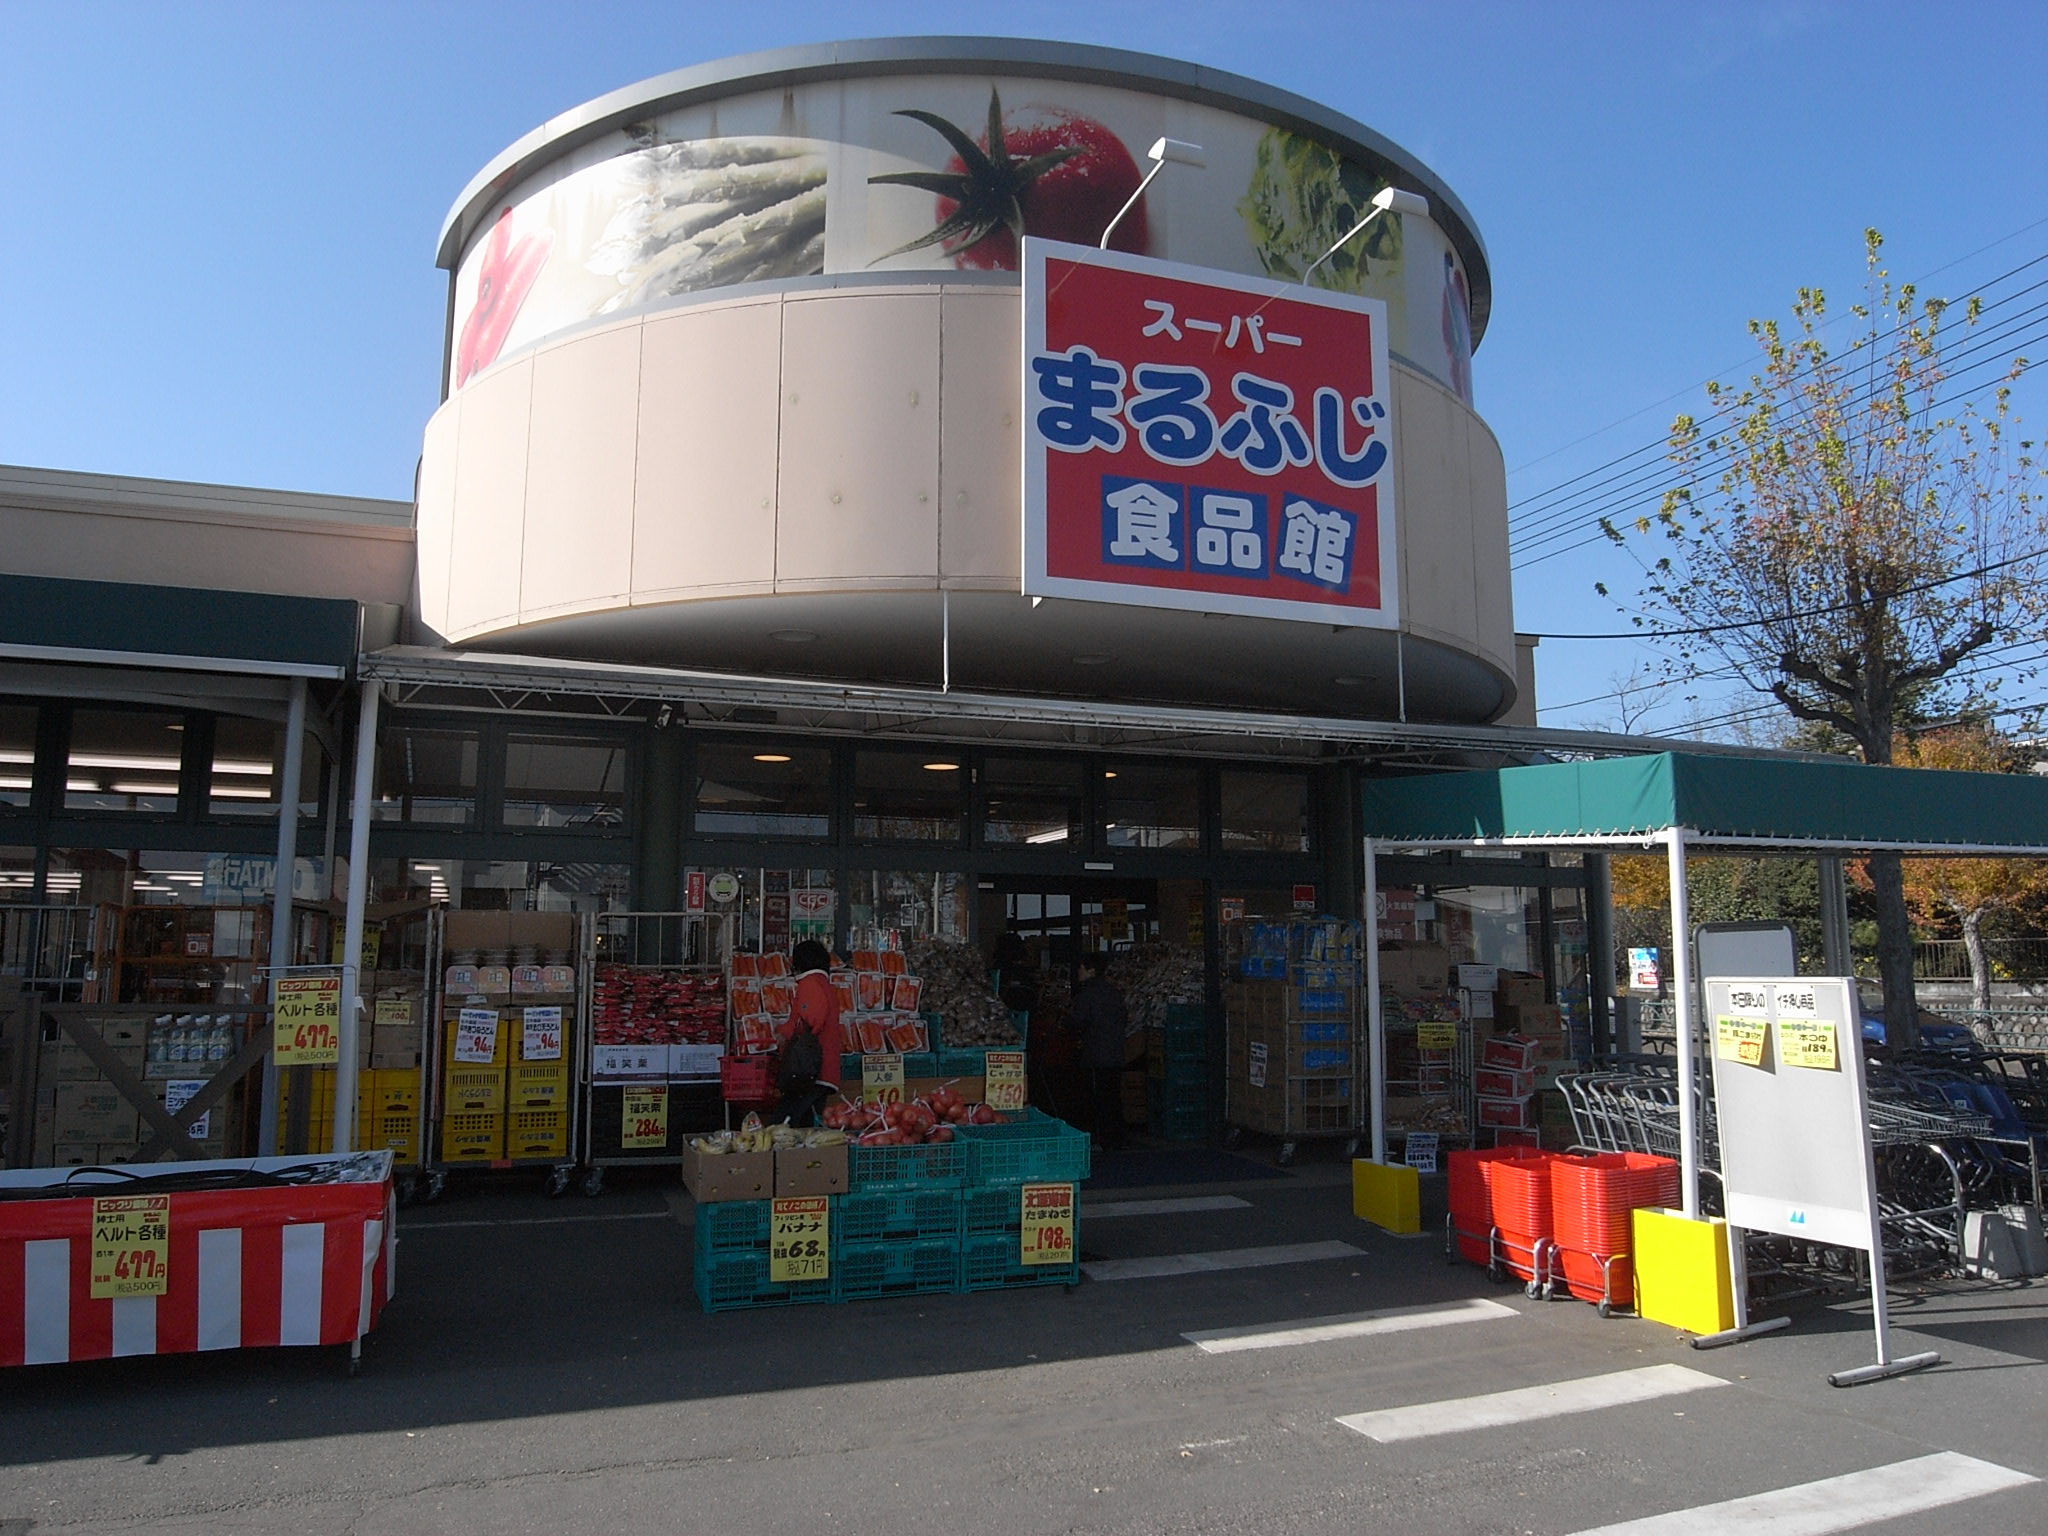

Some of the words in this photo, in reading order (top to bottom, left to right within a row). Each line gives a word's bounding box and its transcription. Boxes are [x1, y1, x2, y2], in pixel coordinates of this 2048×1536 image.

[1142, 299, 1302, 353] スーパー
[1032, 344, 1391, 488] まるふじ
[1106, 482, 1351, 585] 食品館
[1731, 992, 1766, 1008] 本日限りの
[278, 1002, 338, 1017] ベルト各種
[96, 1214, 125, 1224] 紳士用
[1025, 1208, 1071, 1220] たまねぎ
[96, 1224, 167, 1242] ベルト各種
[778, 1221, 823, 1234] バナナ
